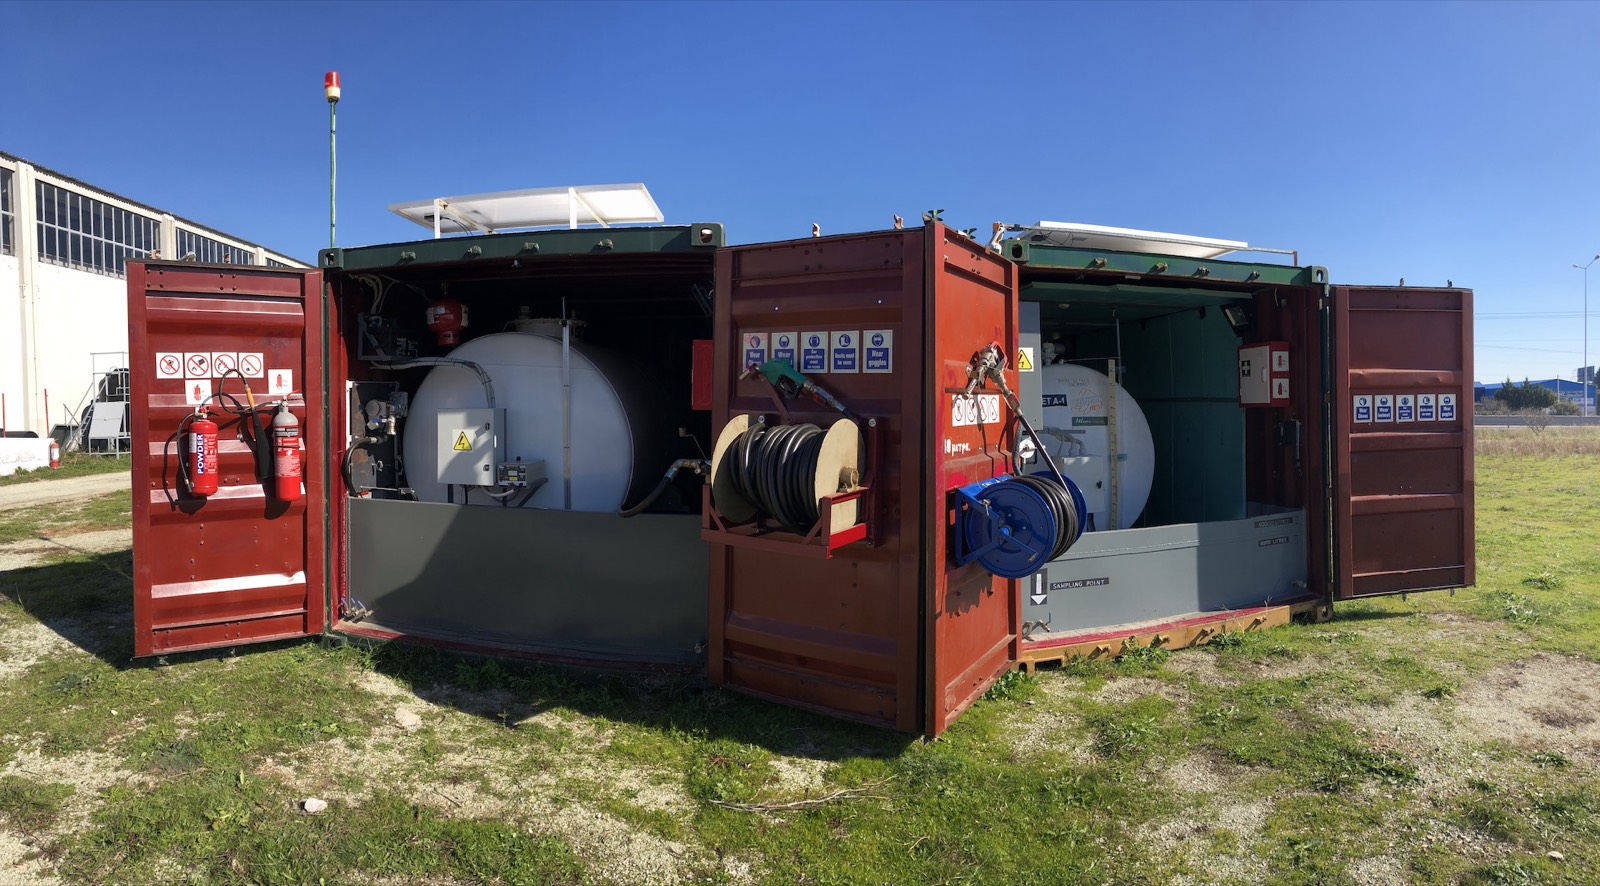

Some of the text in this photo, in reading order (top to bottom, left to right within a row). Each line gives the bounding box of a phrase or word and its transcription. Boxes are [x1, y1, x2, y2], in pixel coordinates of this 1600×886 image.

[868, 358, 887, 368] goggles
[1042, 397, 1052, 405] ET
[1053, 397, 1065, 405] A-1
[1052, 581, 1083, 590] SAMPLING
